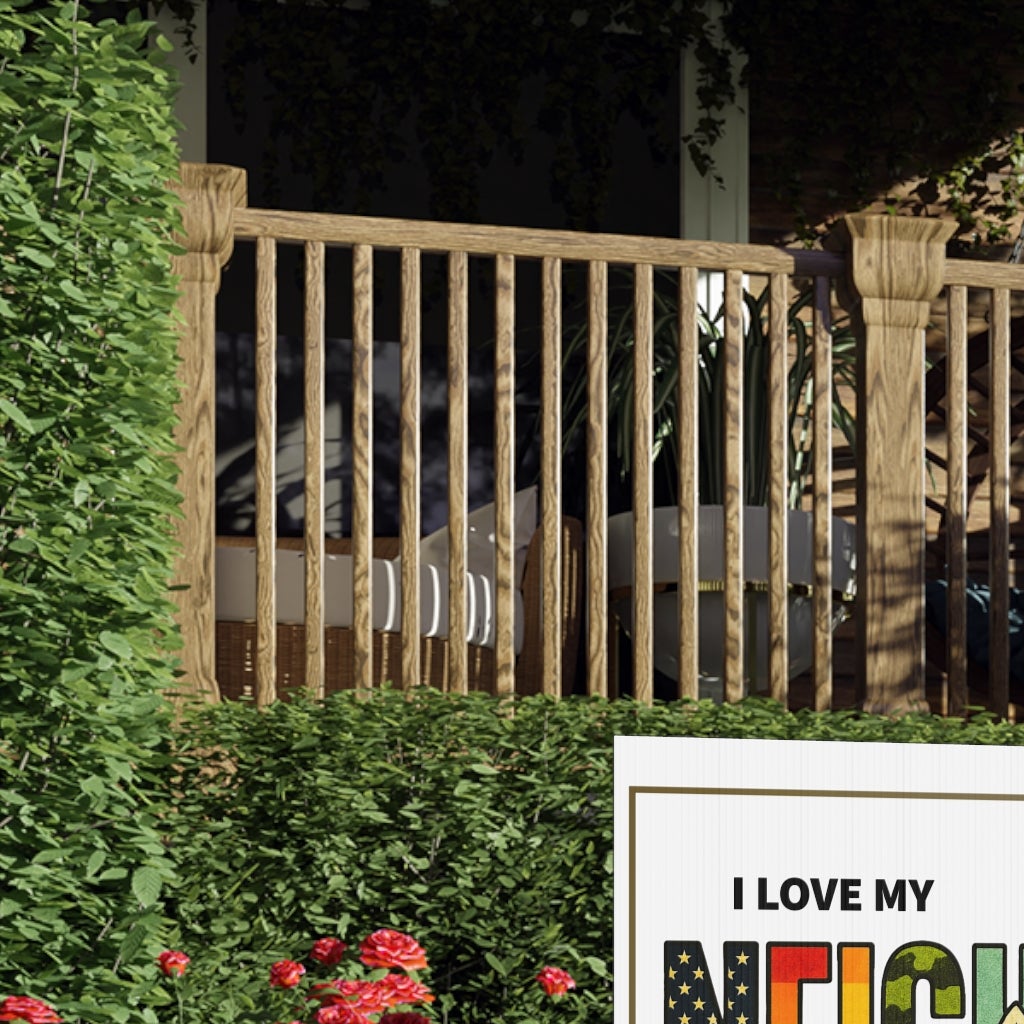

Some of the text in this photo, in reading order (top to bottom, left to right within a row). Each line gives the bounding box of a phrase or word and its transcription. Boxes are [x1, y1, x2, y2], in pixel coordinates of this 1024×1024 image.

[733, 877, 935, 912] I LOVE MY
